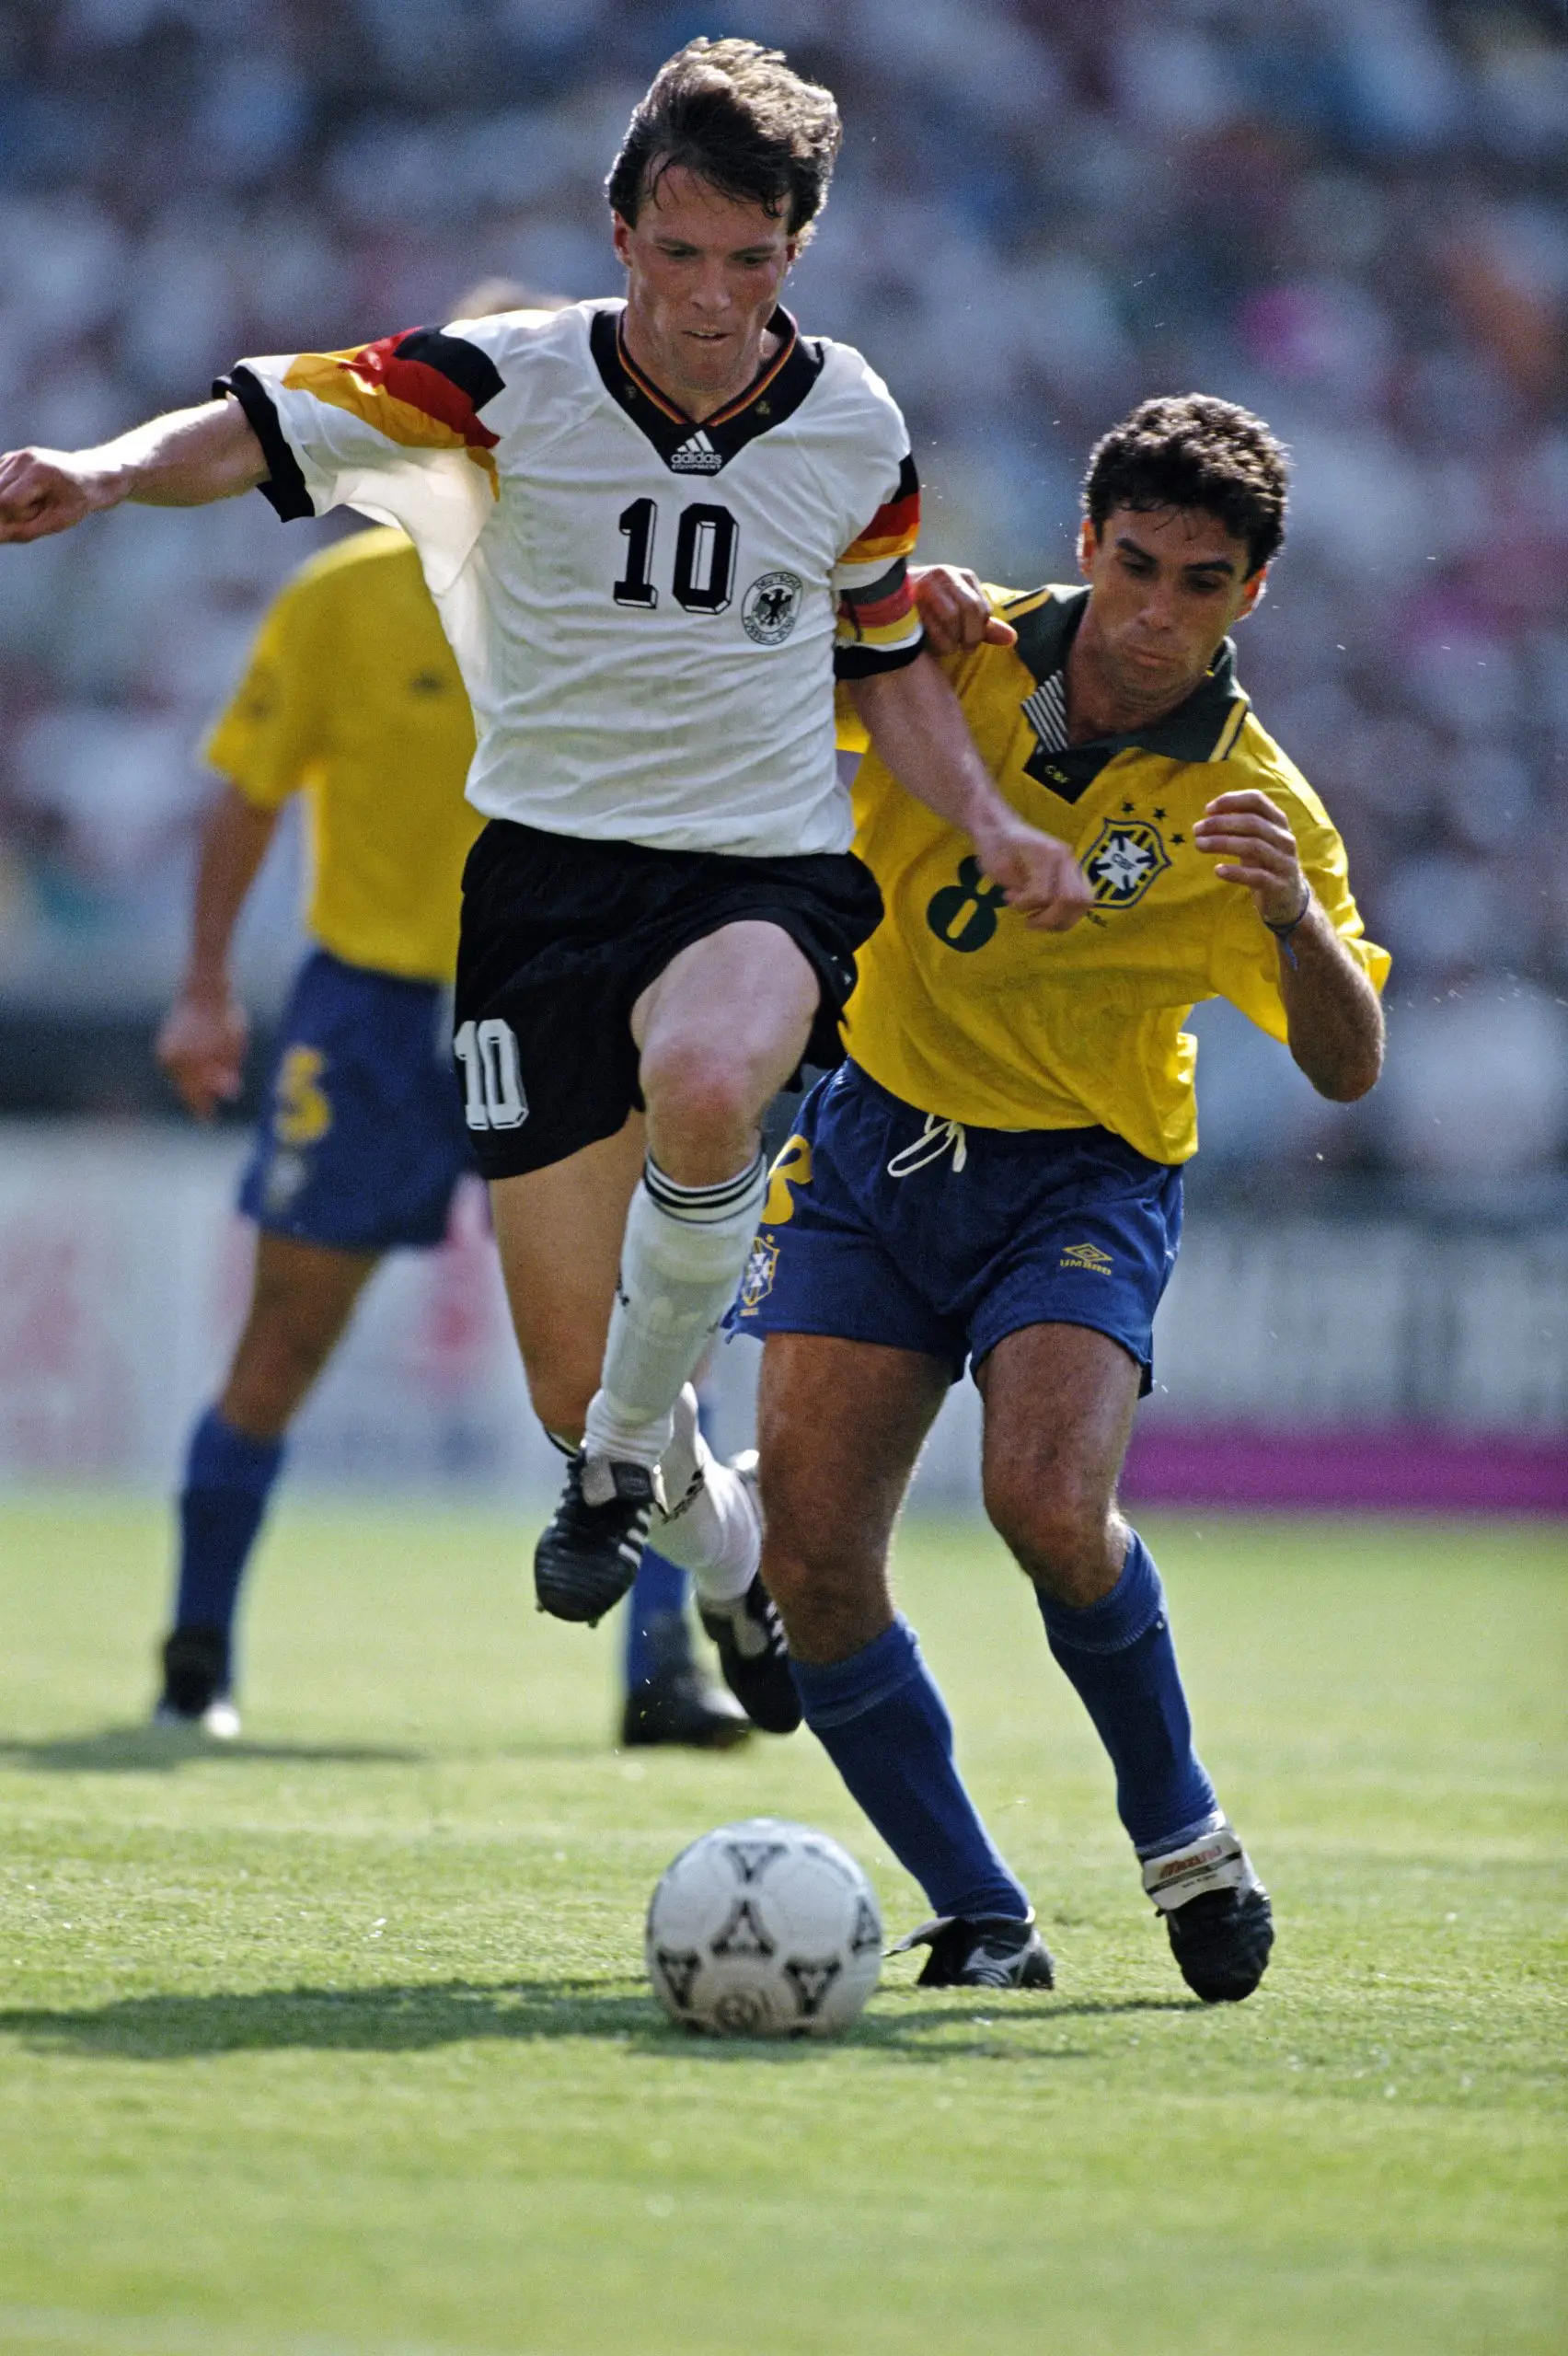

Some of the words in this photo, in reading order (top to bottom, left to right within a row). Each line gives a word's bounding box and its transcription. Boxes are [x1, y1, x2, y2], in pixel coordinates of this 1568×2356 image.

[671, 451, 722, 465] adidas
[614, 498, 739, 615] 10
[926, 855, 1009, 953] 8
[454, 1019, 529, 1130] 10
